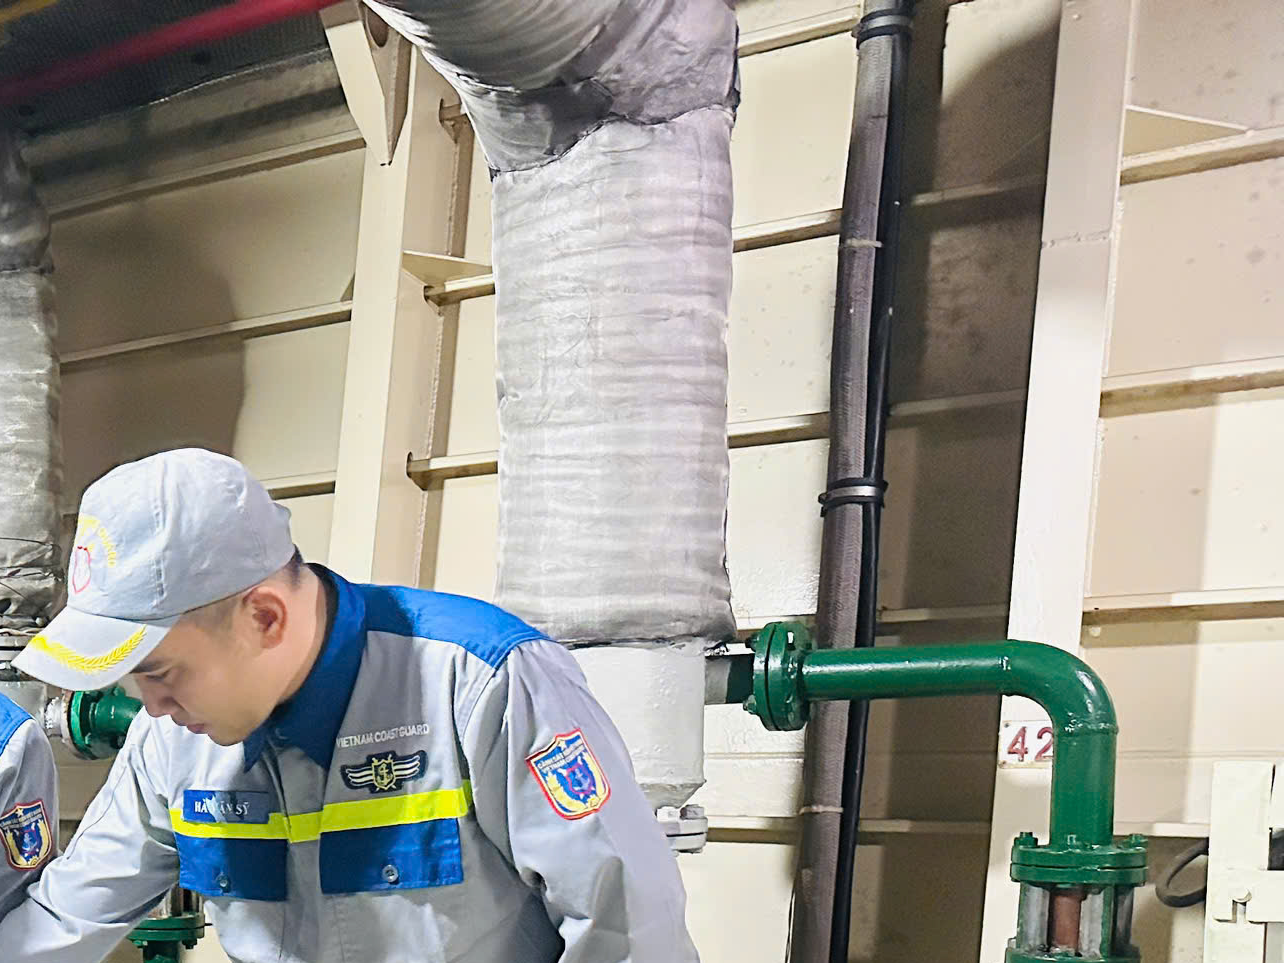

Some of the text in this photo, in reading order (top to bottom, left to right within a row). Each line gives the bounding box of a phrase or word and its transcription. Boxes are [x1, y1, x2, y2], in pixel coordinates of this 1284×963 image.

[336, 723, 430, 748] VIETNAM COAST GUARD
[1007, 726, 1053, 762] 42
